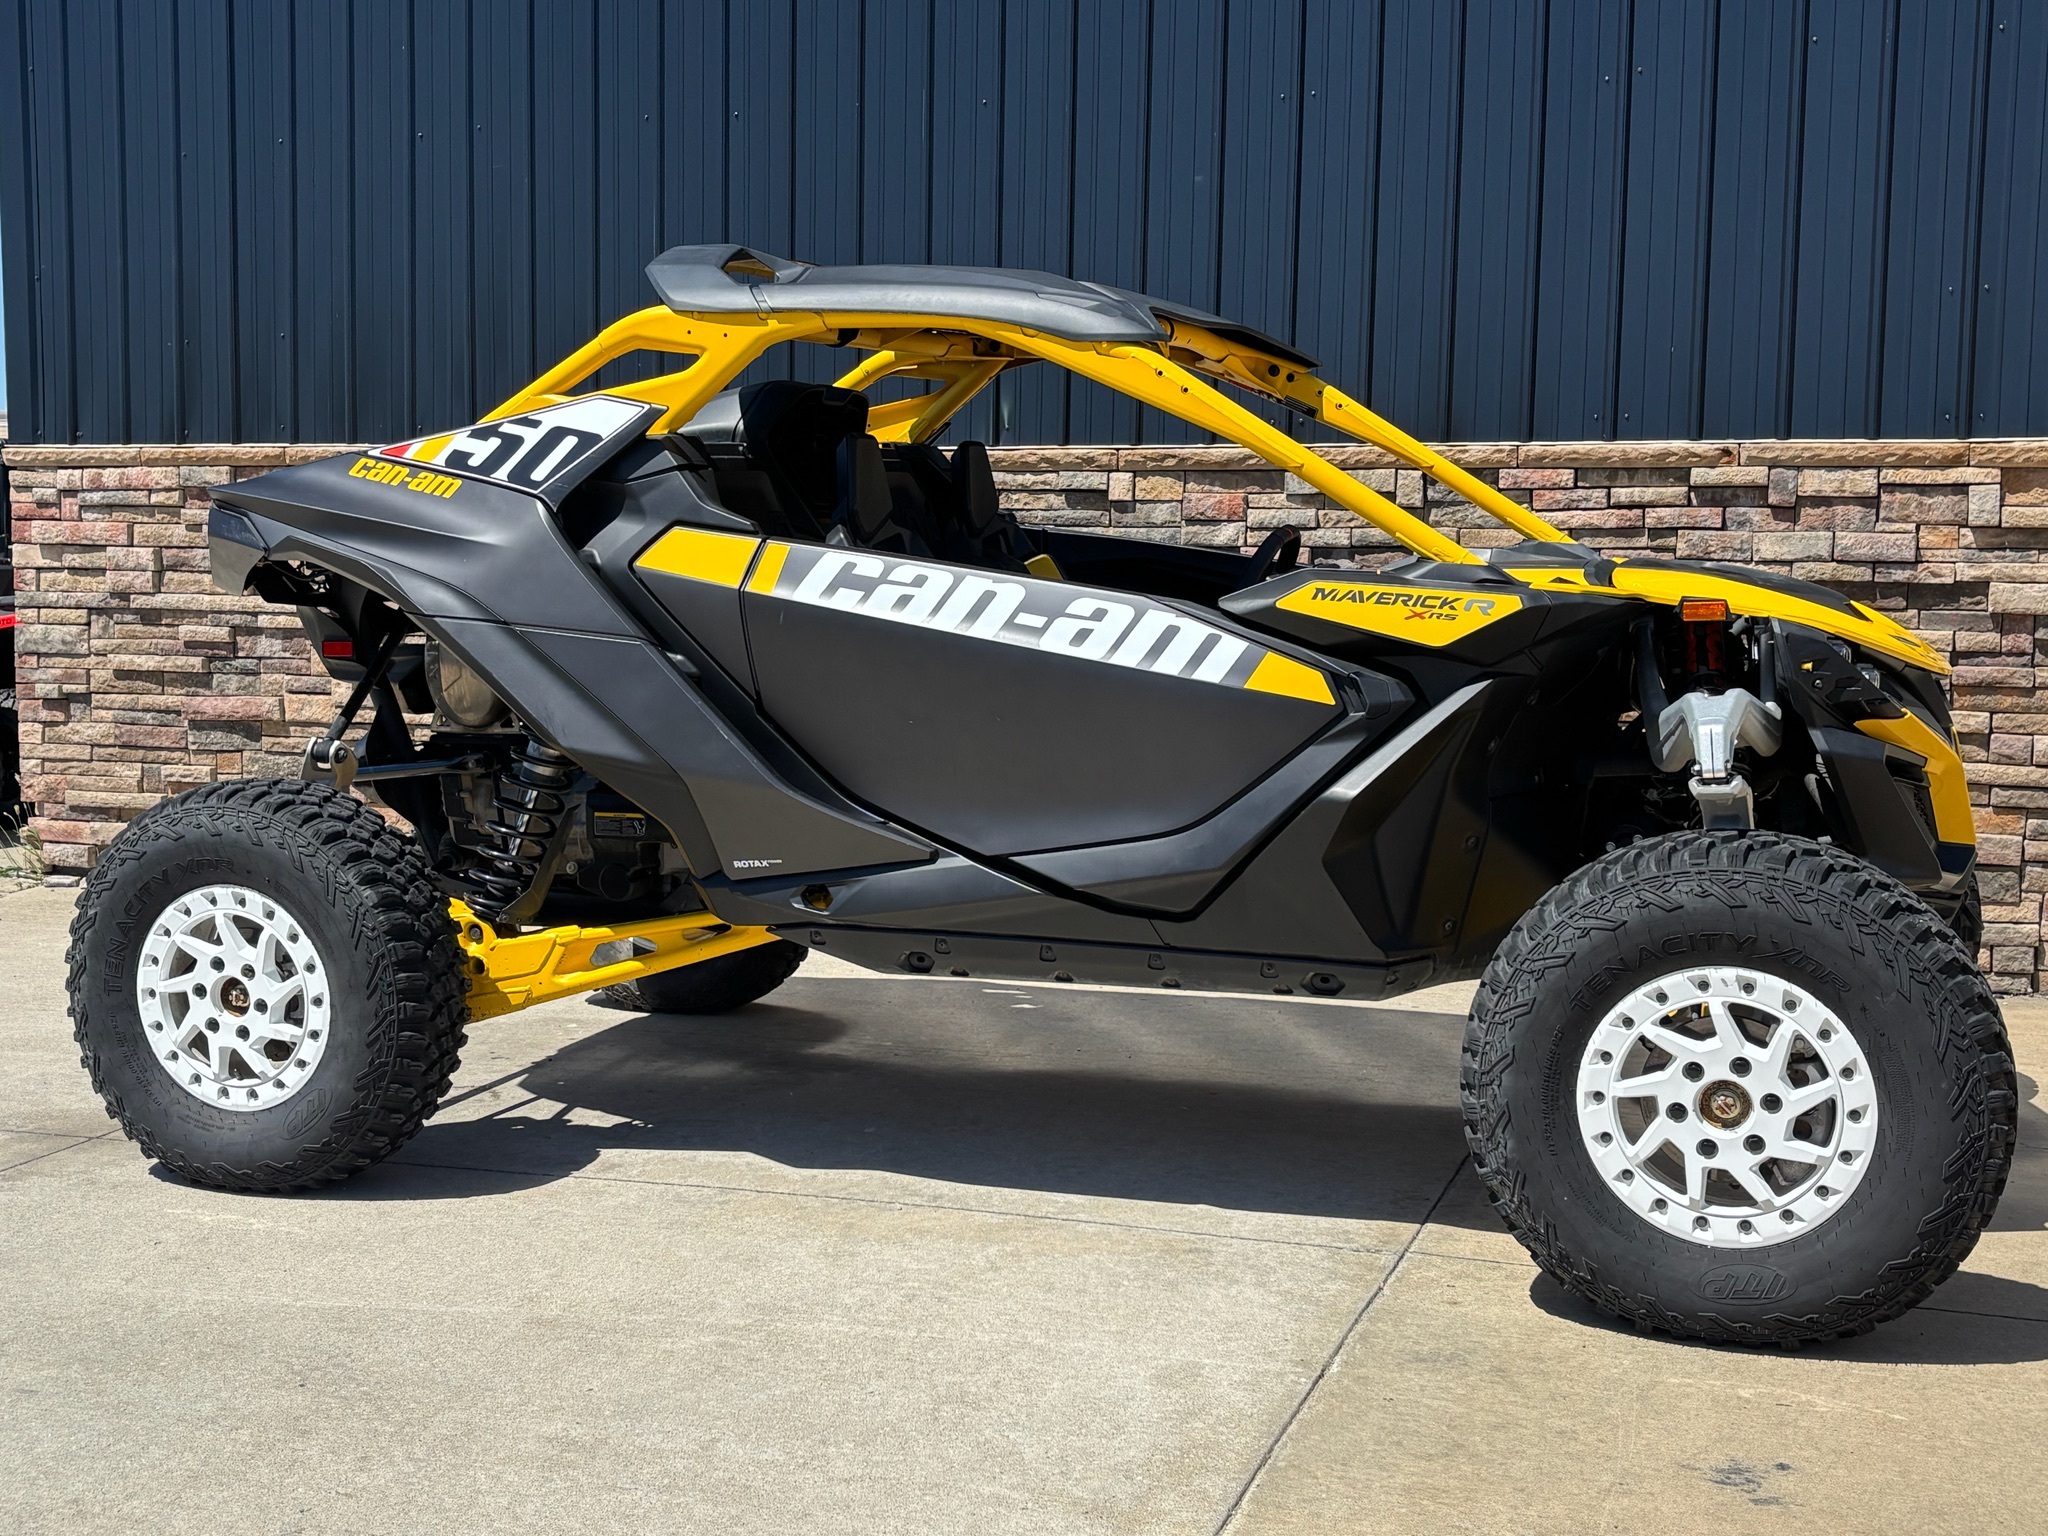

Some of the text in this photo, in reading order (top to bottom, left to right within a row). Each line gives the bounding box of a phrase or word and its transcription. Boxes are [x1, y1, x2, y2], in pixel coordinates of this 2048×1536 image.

[348, 457, 463, 499] can-am
[444, 415, 604, 485] 50
[792, 551, 1250, 684] can-am
[1311, 587, 1496, 617] MAVERICK R
[733, 859, 770, 869] ROTAX
[104, 866, 171, 997] TENACITY
[1571, 929, 1758, 1012] TENACITY
[1700, 1272, 1787, 1300] ITP
